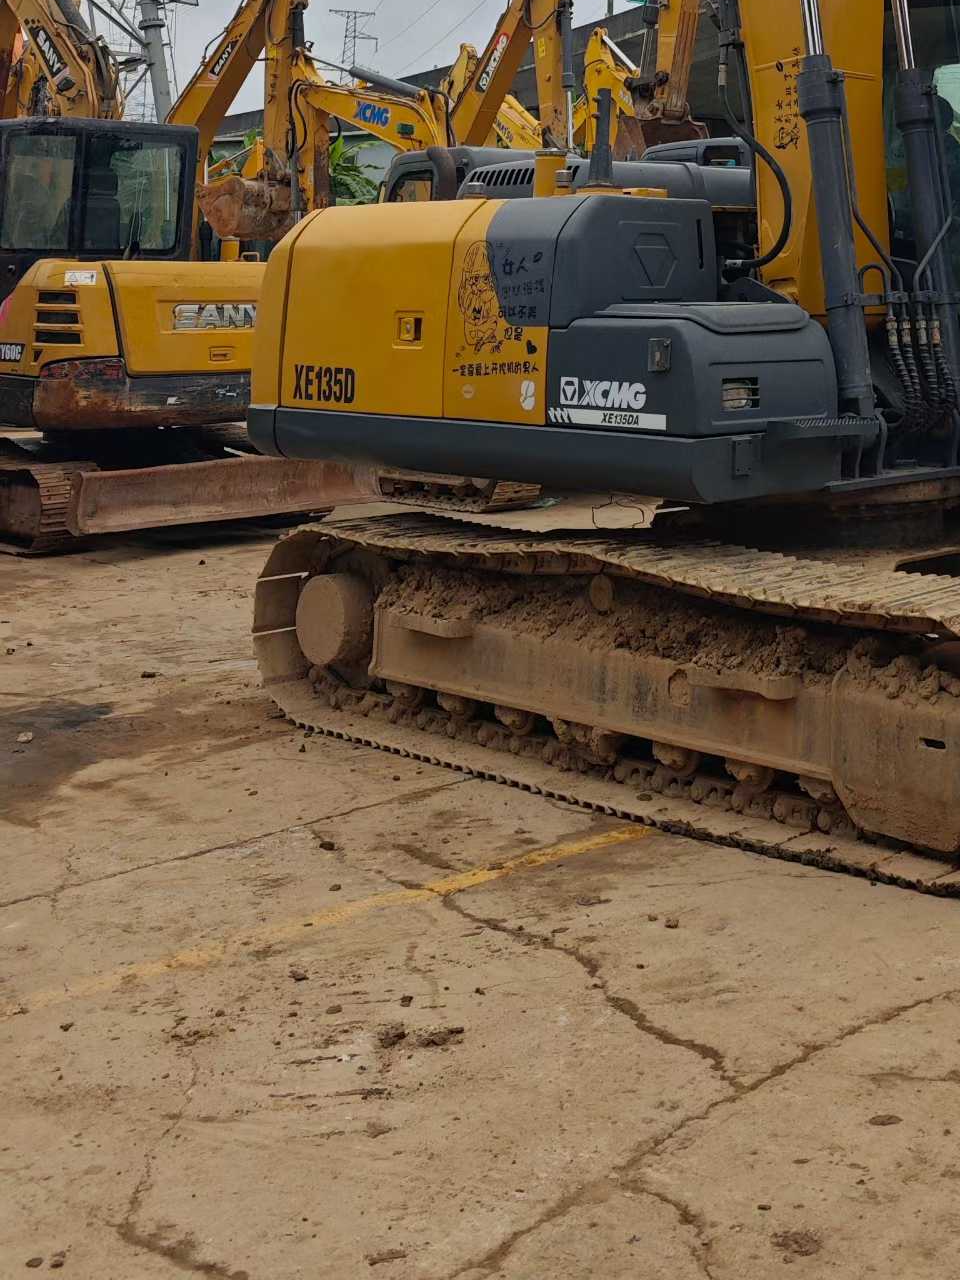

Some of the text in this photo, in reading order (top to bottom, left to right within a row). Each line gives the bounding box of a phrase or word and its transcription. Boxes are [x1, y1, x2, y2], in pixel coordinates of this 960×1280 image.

[353, 100, 390, 127] XCMG
[293, 364, 355, 404] XE135D
[578, 379, 647, 410] XCMG
[601, 412, 640, 426] XE135DA
